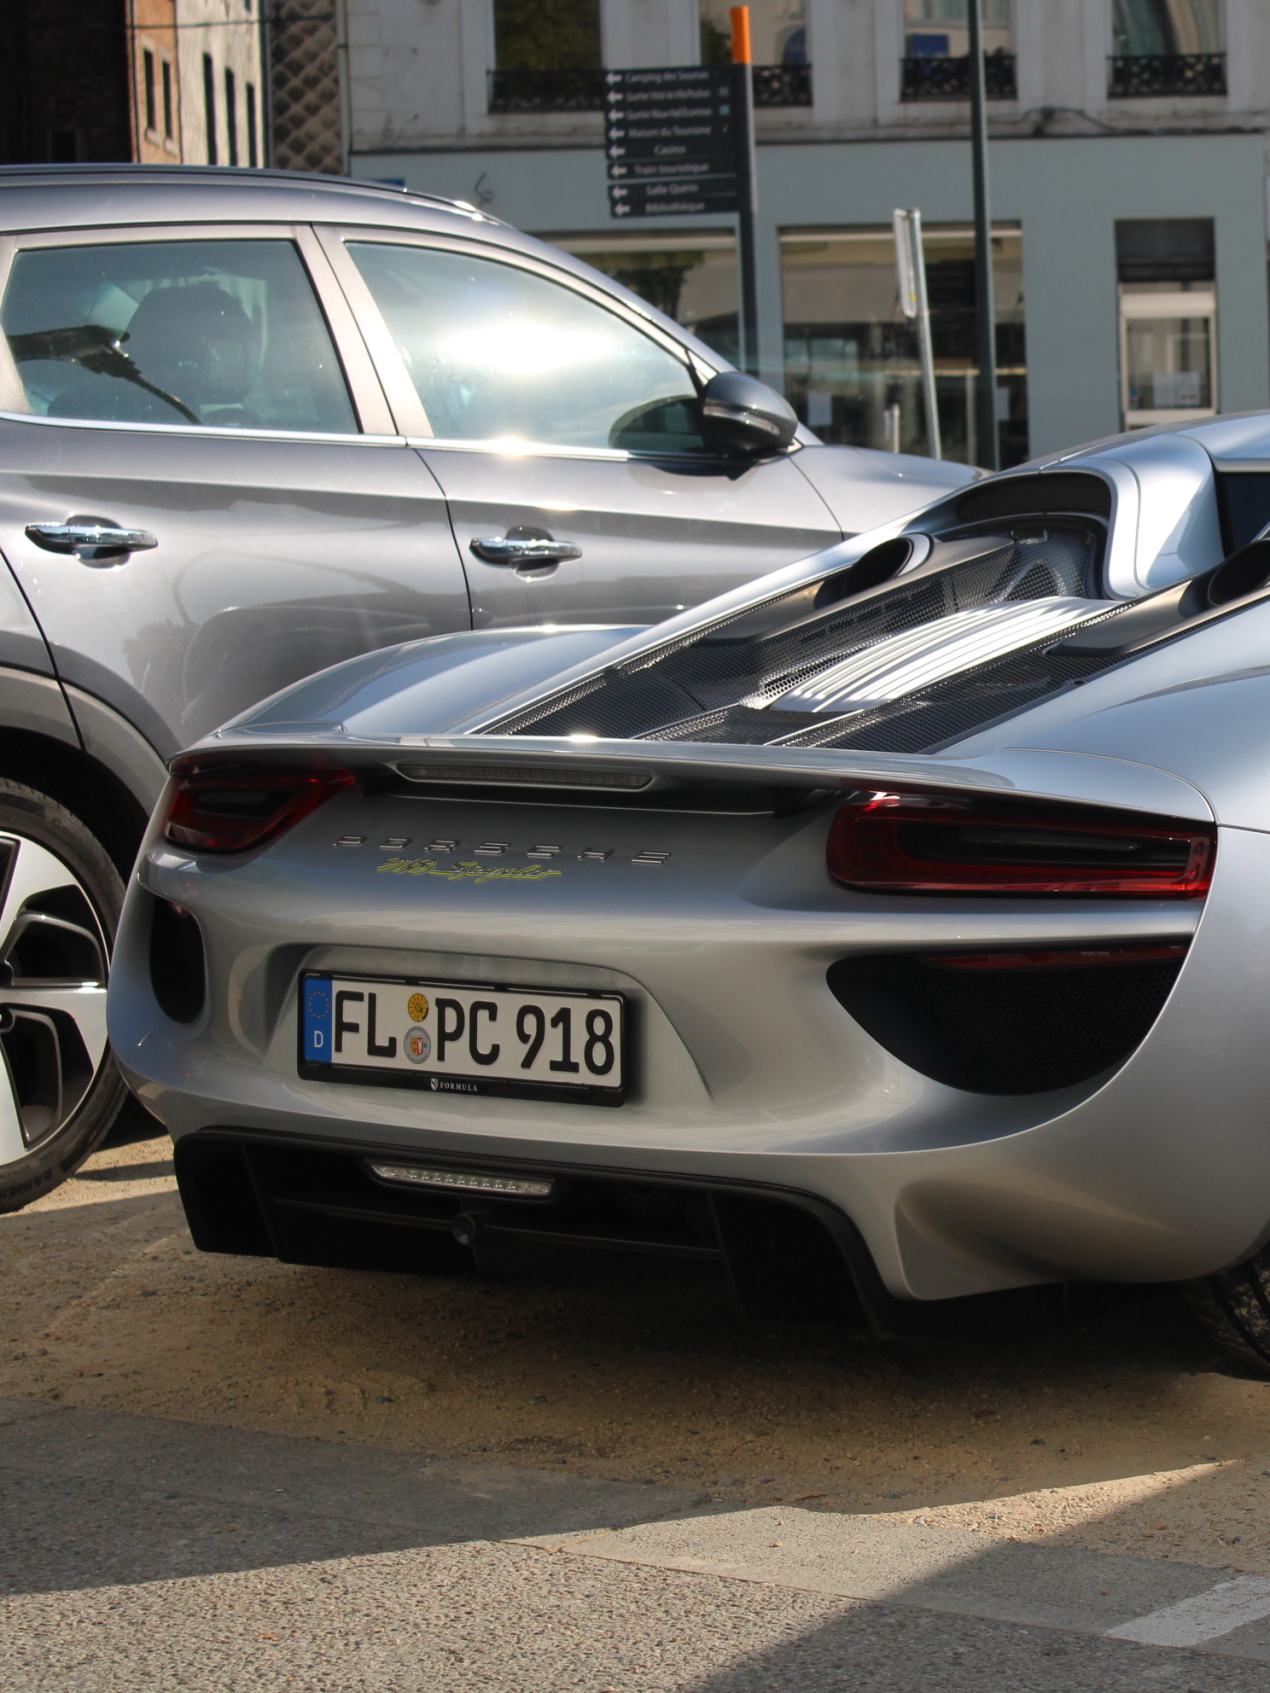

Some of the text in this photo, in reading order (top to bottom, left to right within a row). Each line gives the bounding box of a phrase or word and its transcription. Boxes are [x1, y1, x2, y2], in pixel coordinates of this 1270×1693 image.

[654, 144, 687, 156] Casino
[332, 834, 671, 865] PORSCHE
[376, 857, 562, 884] 918 Spyder
[313, 1030, 324, 1048] D
[334, 989, 397, 1059] FL
[435, 997, 501, 1067] PC
[515, 1004, 616, 1077] 918
[439, 1081, 479, 1093] FORMULA
